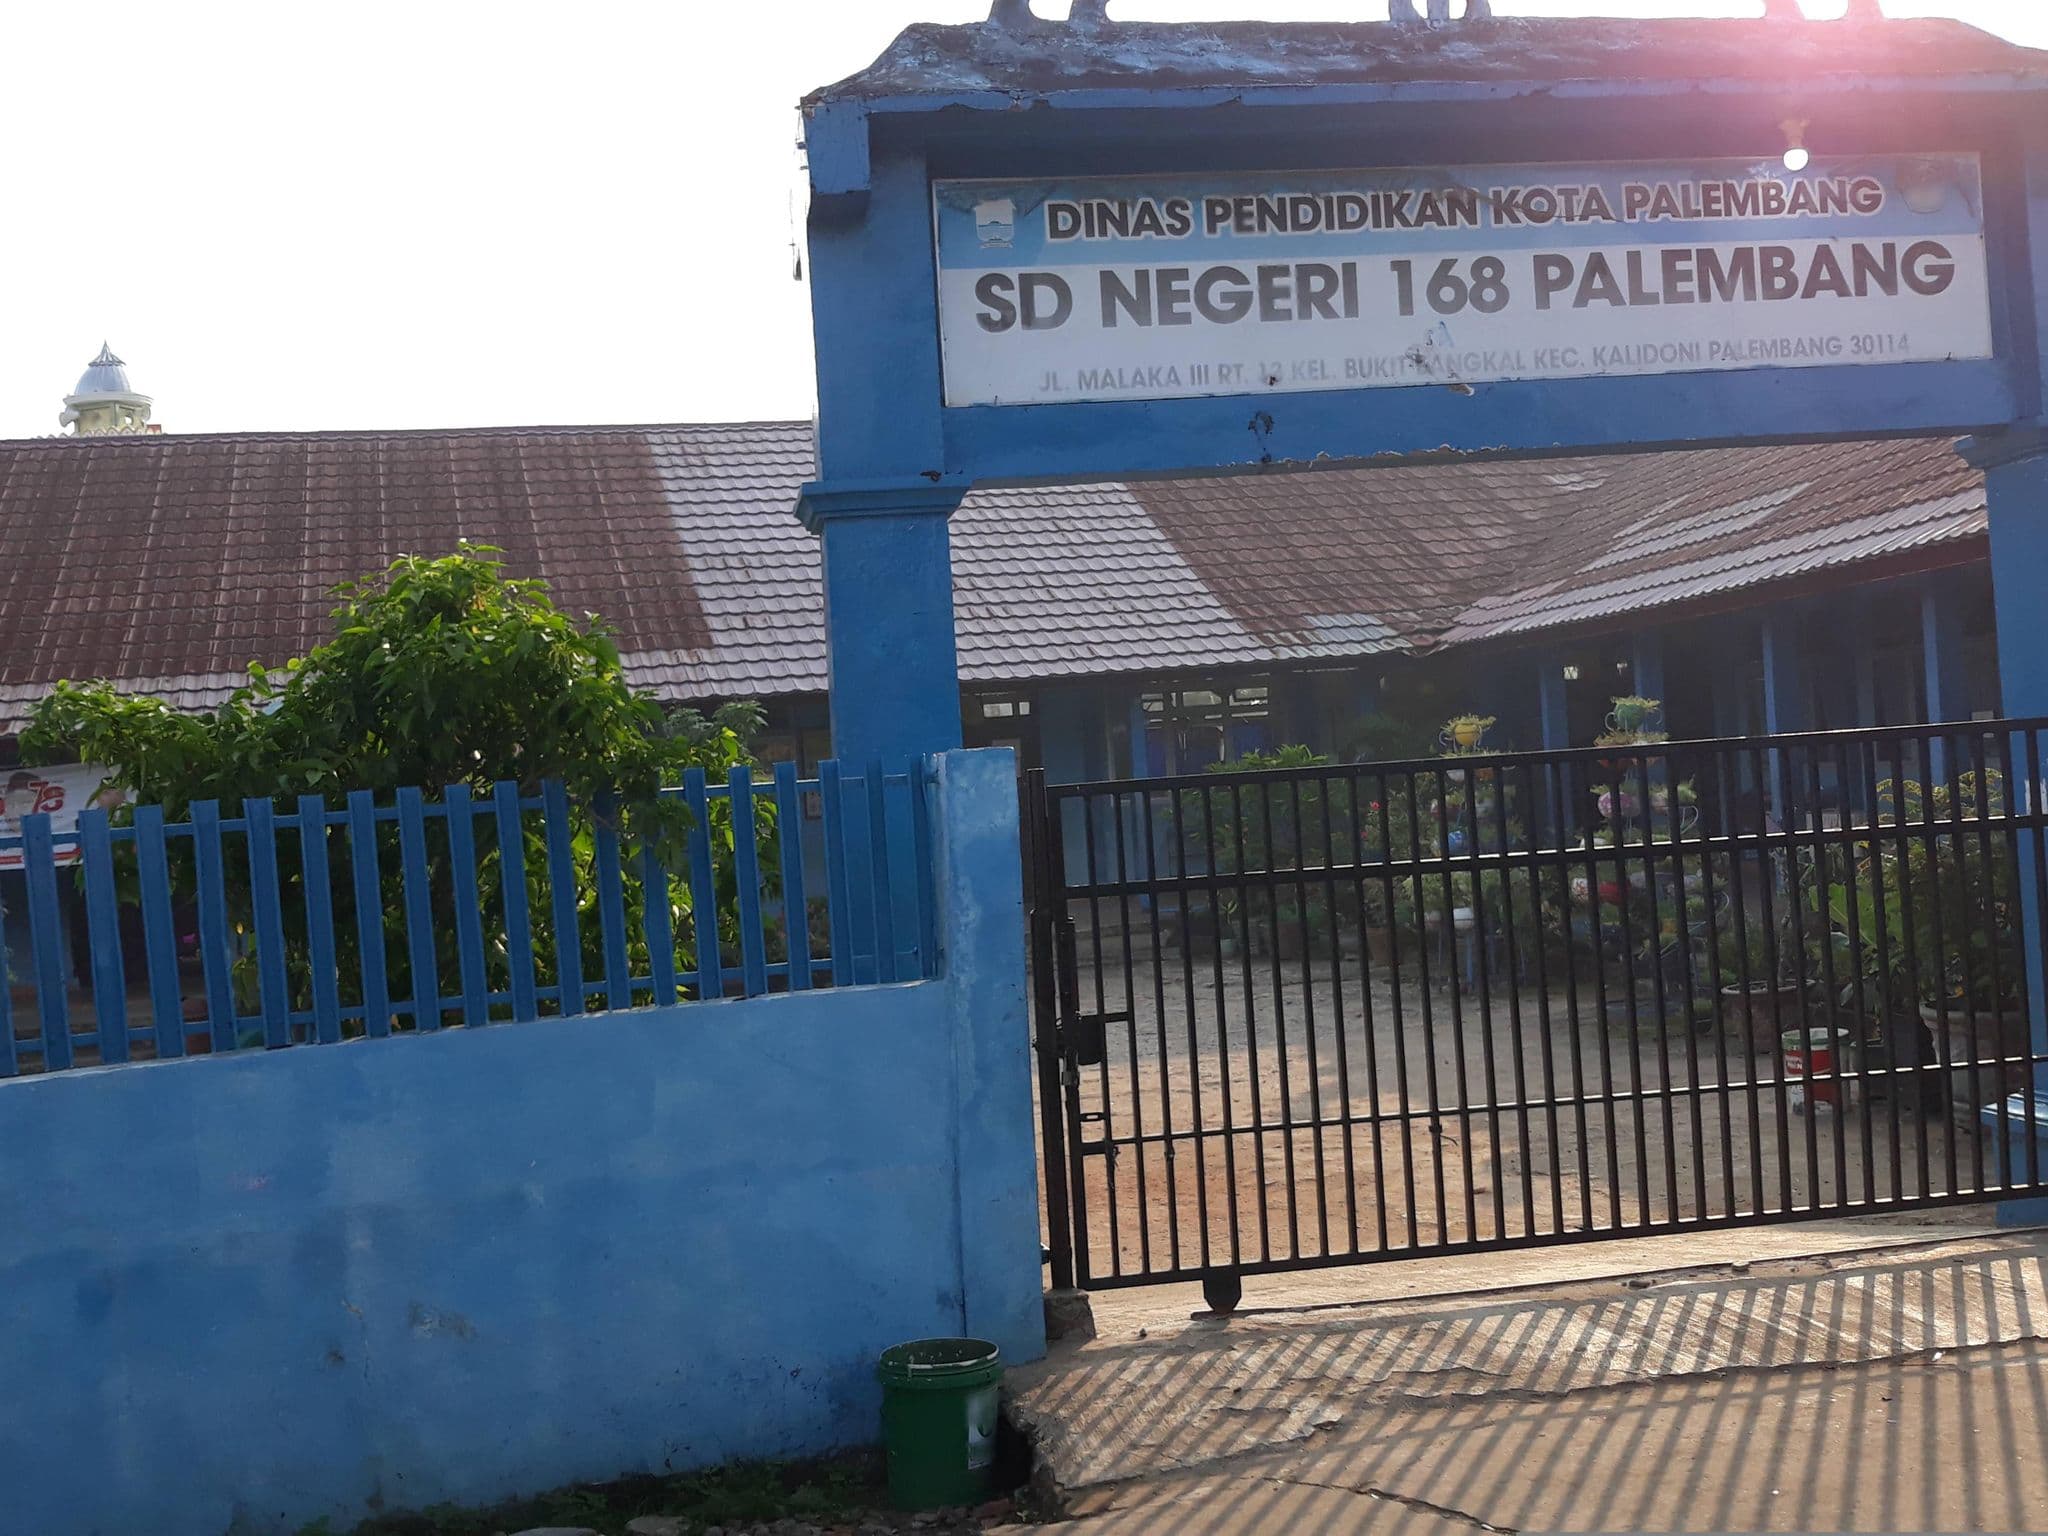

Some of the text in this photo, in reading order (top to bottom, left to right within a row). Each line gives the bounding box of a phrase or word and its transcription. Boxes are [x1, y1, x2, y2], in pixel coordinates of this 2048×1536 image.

[1047, 178, 1884, 240] DINAS PENDIDIKAN KOTA PALEMBANG
[974, 240, 1956, 334] SD NEGERI 168 PALEMBANG
[1039, 370, 1070, 392] JL.
[1077, 365, 1182, 391] MALAKA
[1189, 364, 1210, 386] III
[1217, 362, 1249, 386] RT.
[1292, 359, 1337, 381] KEL.
[1344, 354, 1408, 380] BUKIT
[1413, 349, 1526, 376] ANGKAL
[1534, 349, 1586, 369] KEC.
[1593, 343, 1700, 368] KALIDONI
[1708, 336, 1843, 361] PALEMBANG
[1849, 333, 1911, 355] 30114
